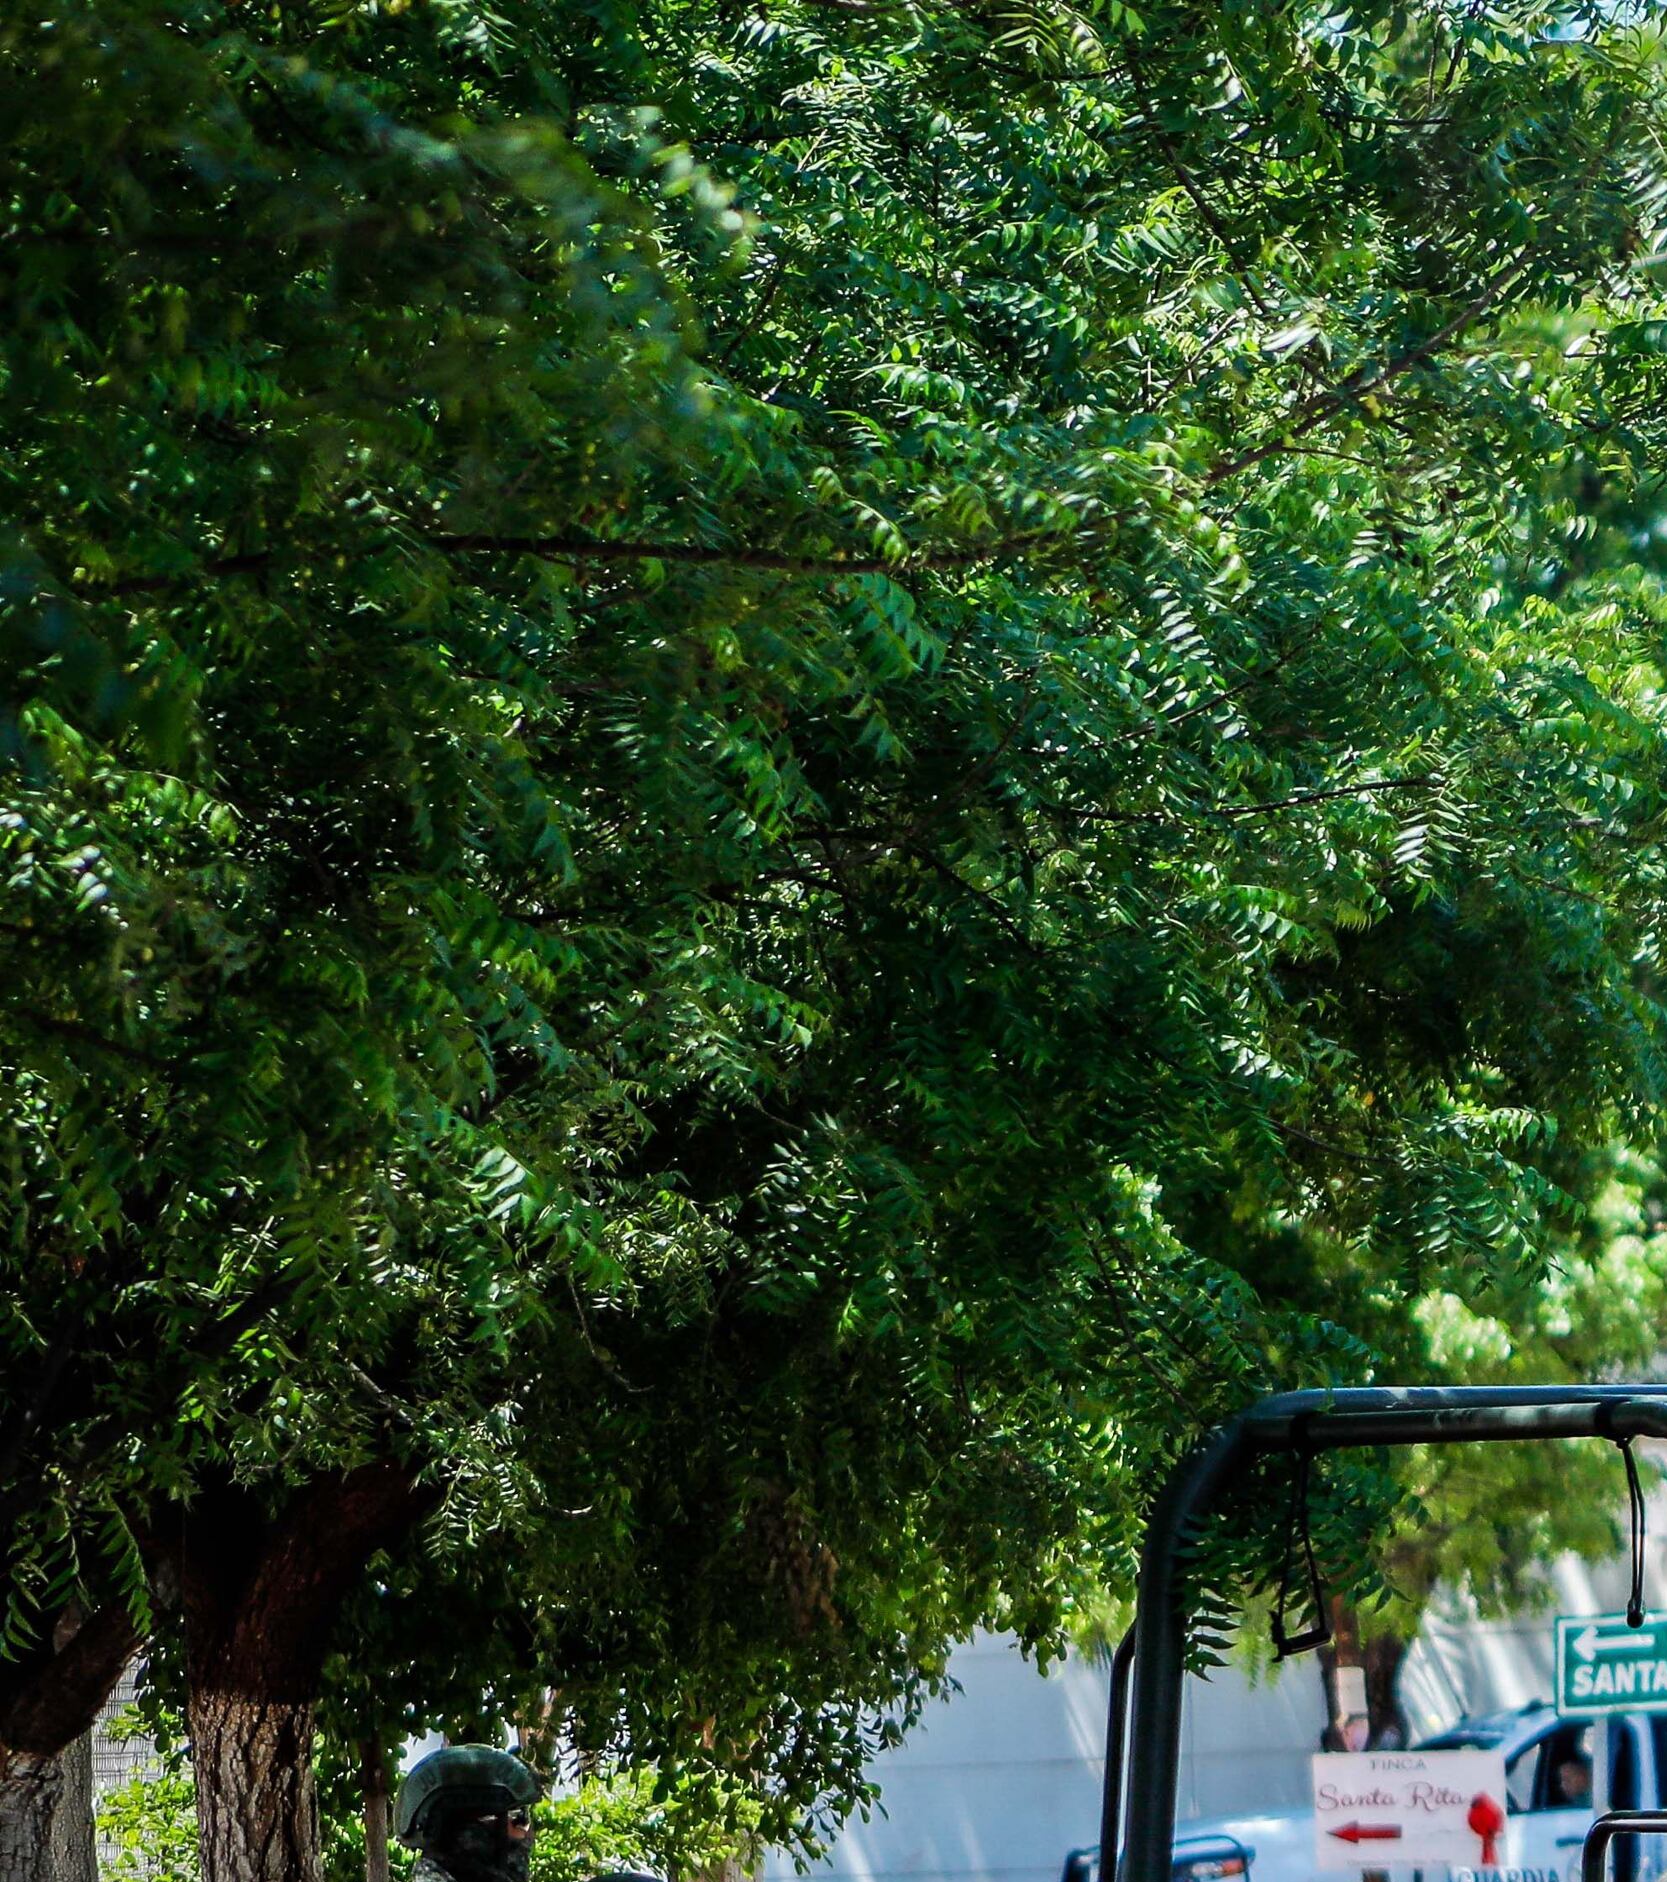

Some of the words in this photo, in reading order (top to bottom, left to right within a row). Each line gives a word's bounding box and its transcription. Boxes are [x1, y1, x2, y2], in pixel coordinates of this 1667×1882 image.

[1369, 1758, 1428, 1771] FINCA
[1316, 1783, 1396, 1811] Santa
[1403, 1780, 1466, 1812] Rita
